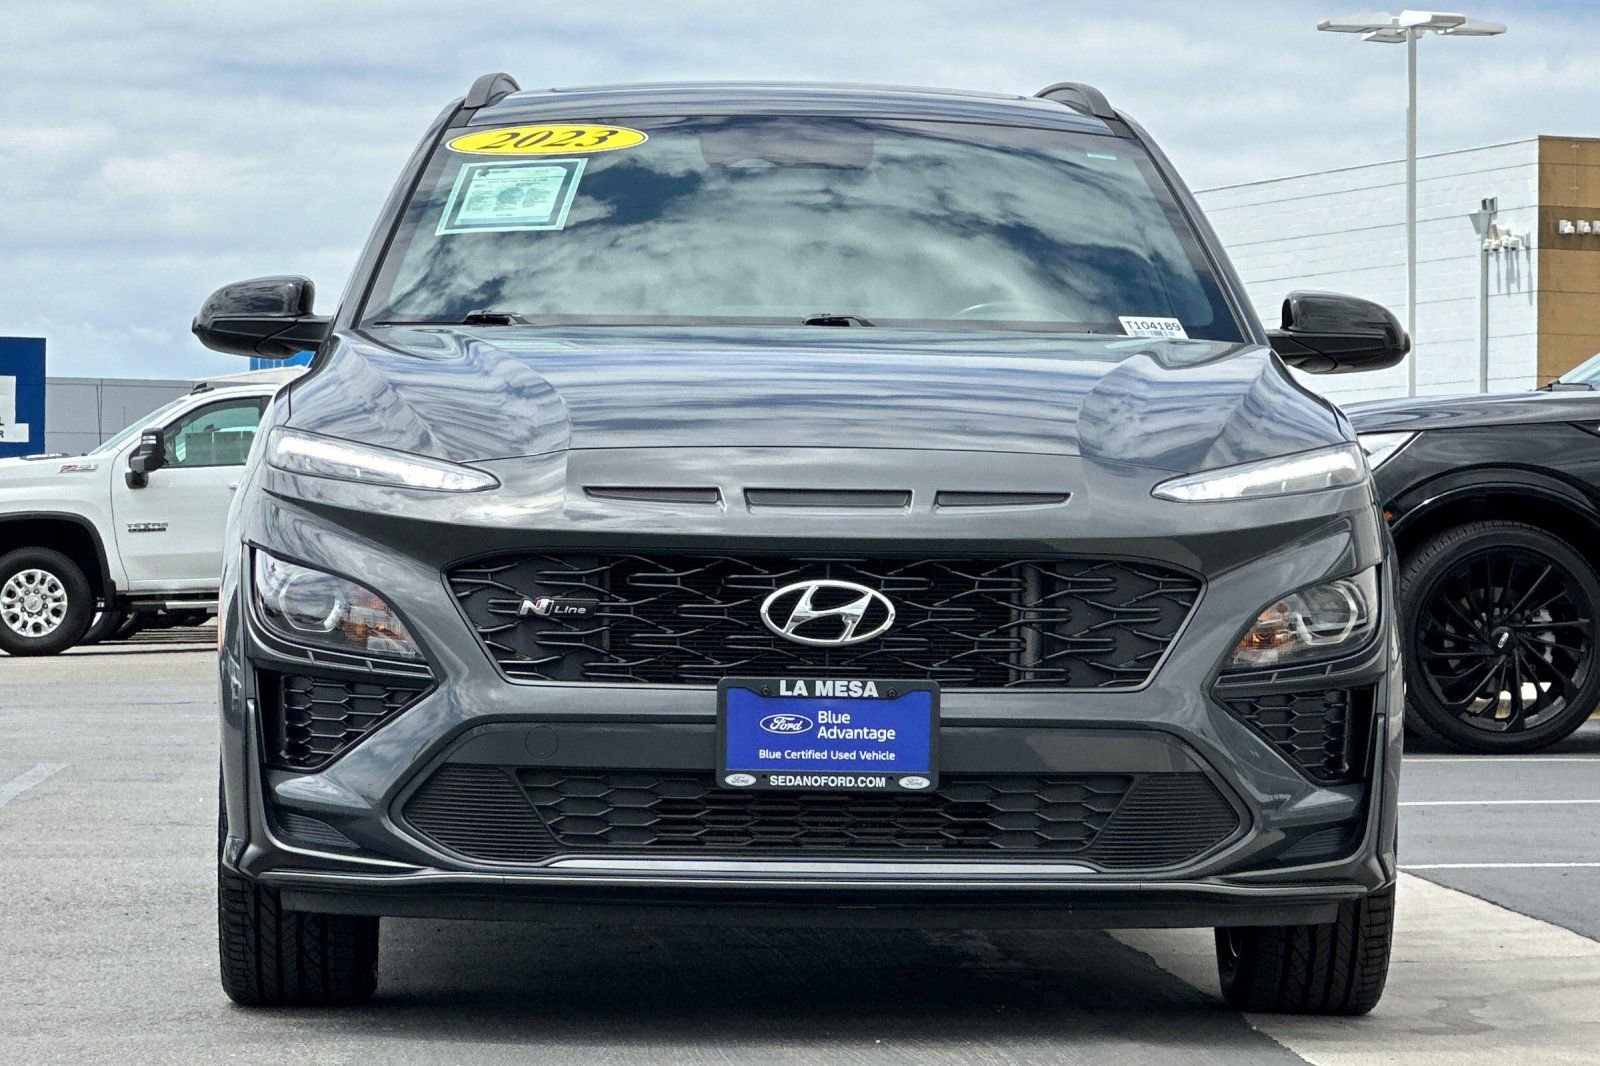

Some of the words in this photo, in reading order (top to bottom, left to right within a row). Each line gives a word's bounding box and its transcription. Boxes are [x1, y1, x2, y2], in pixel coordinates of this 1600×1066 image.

[477, 130, 618, 149] 2023
[1125, 321, 1181, 331] T104189
[779, 679, 808, 697] LA
[815, 680, 879, 698] MESA
[769, 715, 803, 732] Ford
[817, 710, 851, 724] Blue
[817, 725, 896, 742] Advantage
[758, 749, 782, 760] Blue
[784, 749, 828, 760] Certified
[830, 749, 857, 761] Used
[859, 750, 896, 761] Vehicle
[769, 774, 886, 788] SEDANOFORD.COM
